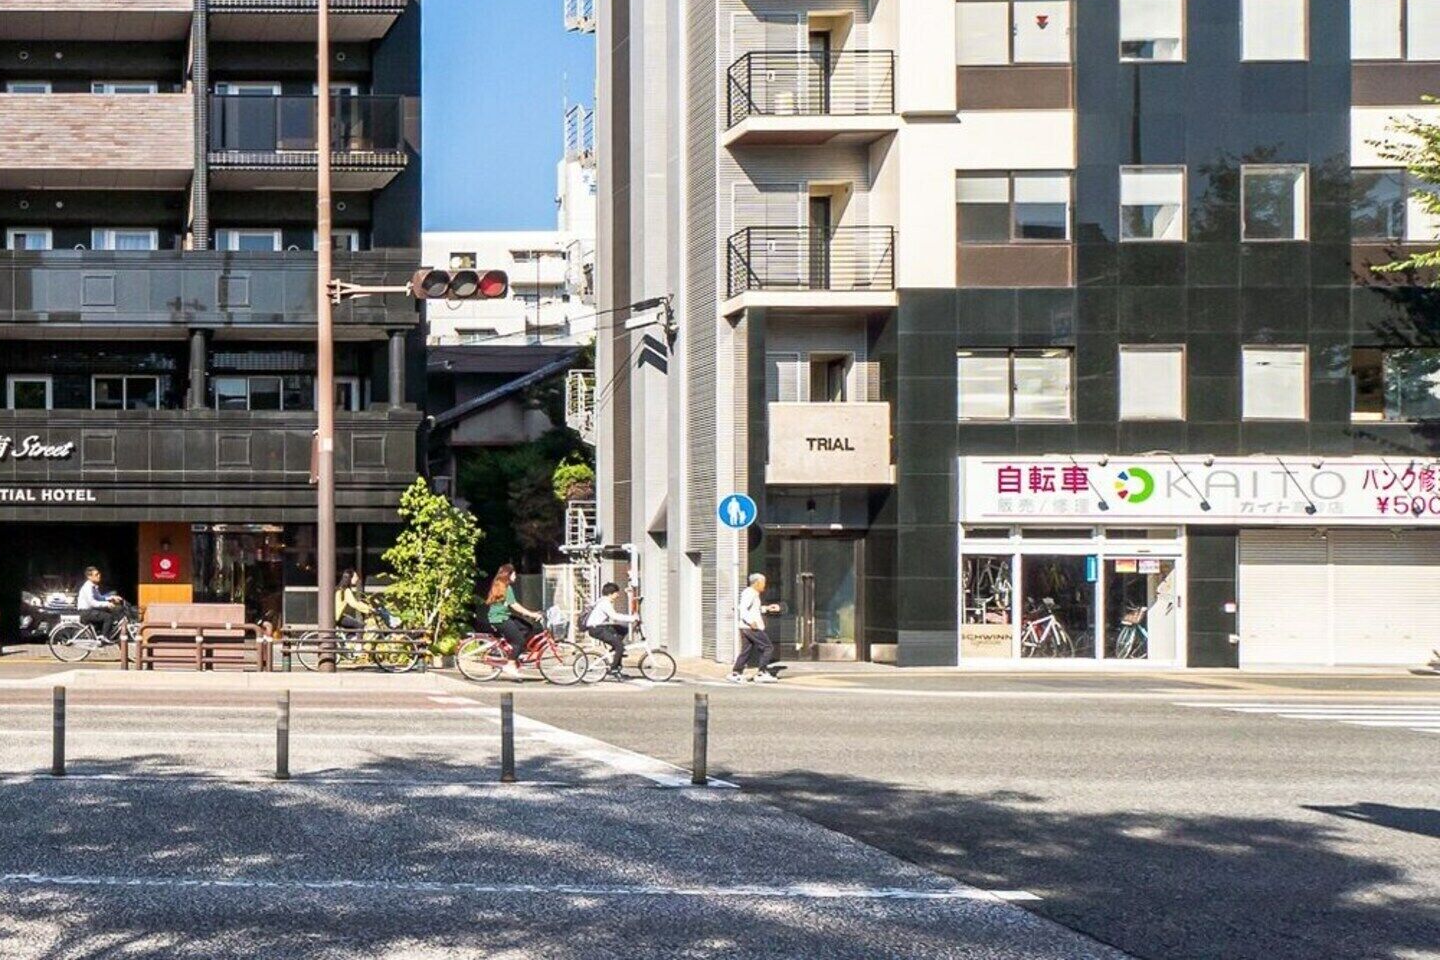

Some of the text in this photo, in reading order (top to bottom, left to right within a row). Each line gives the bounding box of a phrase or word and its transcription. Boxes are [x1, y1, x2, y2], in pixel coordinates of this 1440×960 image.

[11, 434, 74, 458] Street
[805, 437, 856, 451] TRIAL
[997, 465, 1090, 494] 自転車
[1166, 469, 1346, 500] KAITO
[1362, 468, 1440, 493] パンク修
[41, 488, 97, 501] HOTEL
